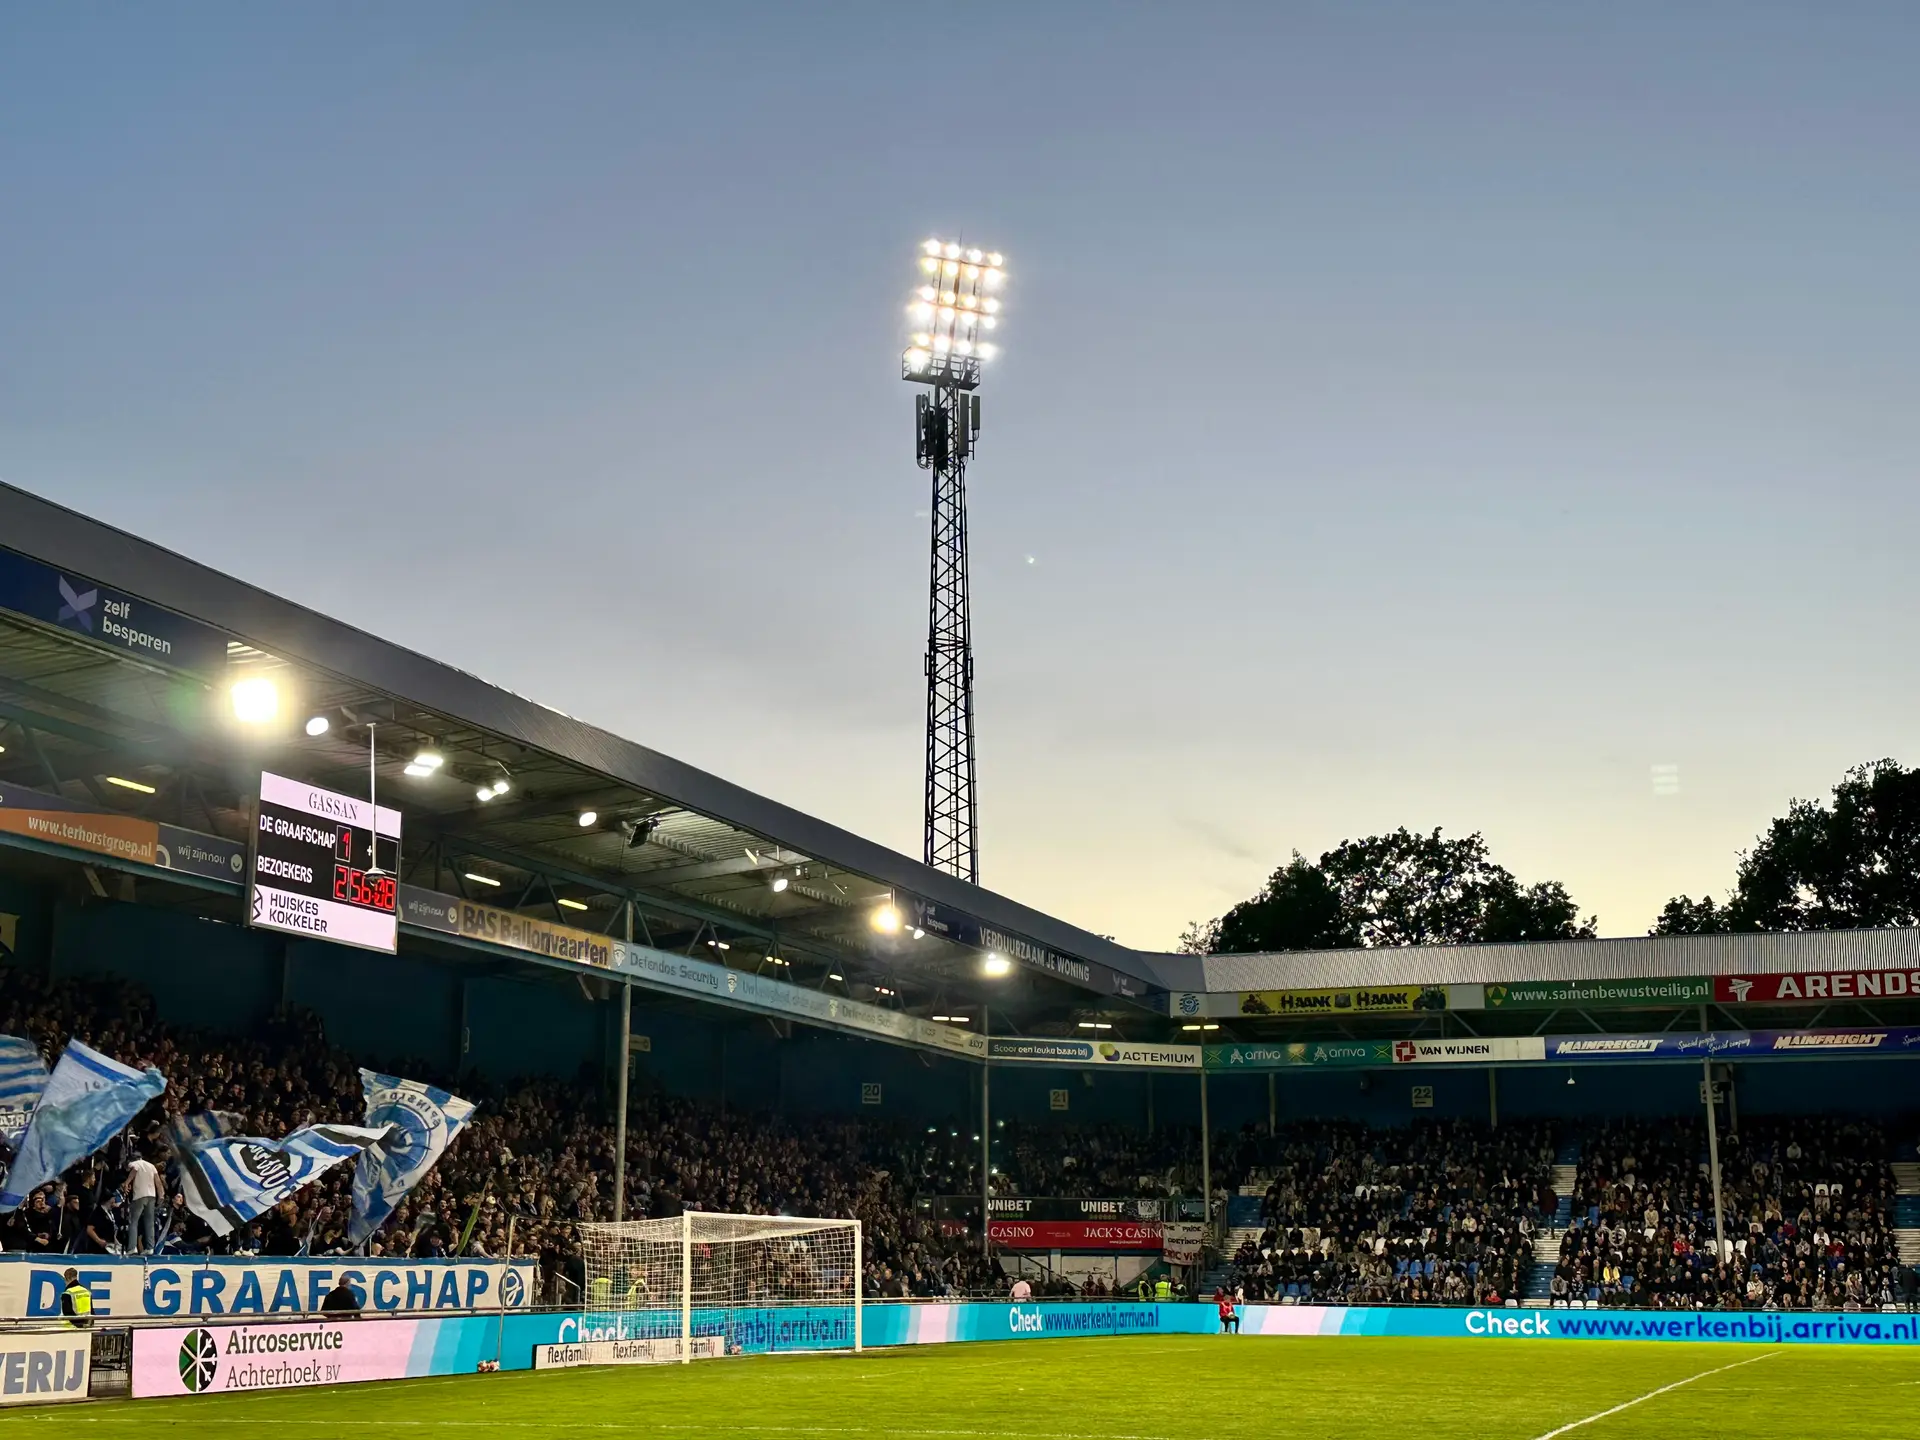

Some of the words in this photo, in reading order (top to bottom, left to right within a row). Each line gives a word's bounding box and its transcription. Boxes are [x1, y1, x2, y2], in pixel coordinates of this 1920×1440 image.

[104, 599, 130, 619] zelf
[102, 616, 171, 654] besparen
[308, 791, 358, 820] GASSAN
[28, 816, 152, 858] www.terhorstgroep.nl
[260, 814, 274, 832] DE
[274, 818, 336, 849] GRAAFSCHAP
[342, 832, 350, 858] 1
[178, 845, 191, 860] wij
[257, 855, 313, 884] BEZOEKERS
[335, 866, 347, 898] 2
[270, 892, 319, 916] HUISKES
[269, 908, 328, 933] KOKKELER
[463, 905, 498, 939] BAS
[500, 916, 608, 966] Ballonvaarten
[979, 926, 1045, 967] VERDUURZAAM
[1045, 951, 1056, 971] JE
[1056, 956, 1090, 982] WONING
[630, 952, 677, 976] Defendos
[678, 964, 719, 989] Security
[1281, 993, 1332, 1009] HAANK
[1357, 991, 1408, 1007] HAANK
[1511, 982, 1709, 1001] www.samenbewustveilig.nl
[1419, 1046, 1443, 1056] VAN
[1445, 1044, 1490, 1055] WIJNEN
[1556, 1039, 1663, 1054] MAINFREIGHT
[1773, 1034, 1888, 1049] MAINFREIGHT
[1122, 1051, 1195, 1064] ACTEMIUM
[1245, 1050, 1281, 1060] arriva
[1329, 1047, 1366, 1058] arriva
[864, 1085, 880, 1096] 20
[1413, 1087, 1431, 1098] 22
[987, 1200, 1032, 1212] UNIBET
[1080, 1201, 1125, 1213] UNIBET
[990, 1226, 1034, 1238] CASINO
[1084, 1227, 1123, 1239] JACK'S
[26, 1269, 112, 1316] DE
[142, 1268, 490, 1315] GRAAFSCHAP
[1009, 1306, 1043, 1332] Check
[1044, 1305, 1159, 1336] www.werkenbij.arriva.nl
[1465, 1311, 1550, 1335] Check
[1558, 1314, 1917, 1342] www.werkenbij.arriva.nl
[225, 1324, 343, 1354] Aircoservice
[675, 1335, 716, 1359] flfamily
[547, 1344, 593, 1363] flexfamily
[612, 1340, 656, 1360] flexfamily
[0, 1349, 85, 1394] ERIJ
[225, 1359, 321, 1388] Achterhoek
[325, 1364, 341, 1382] BV
